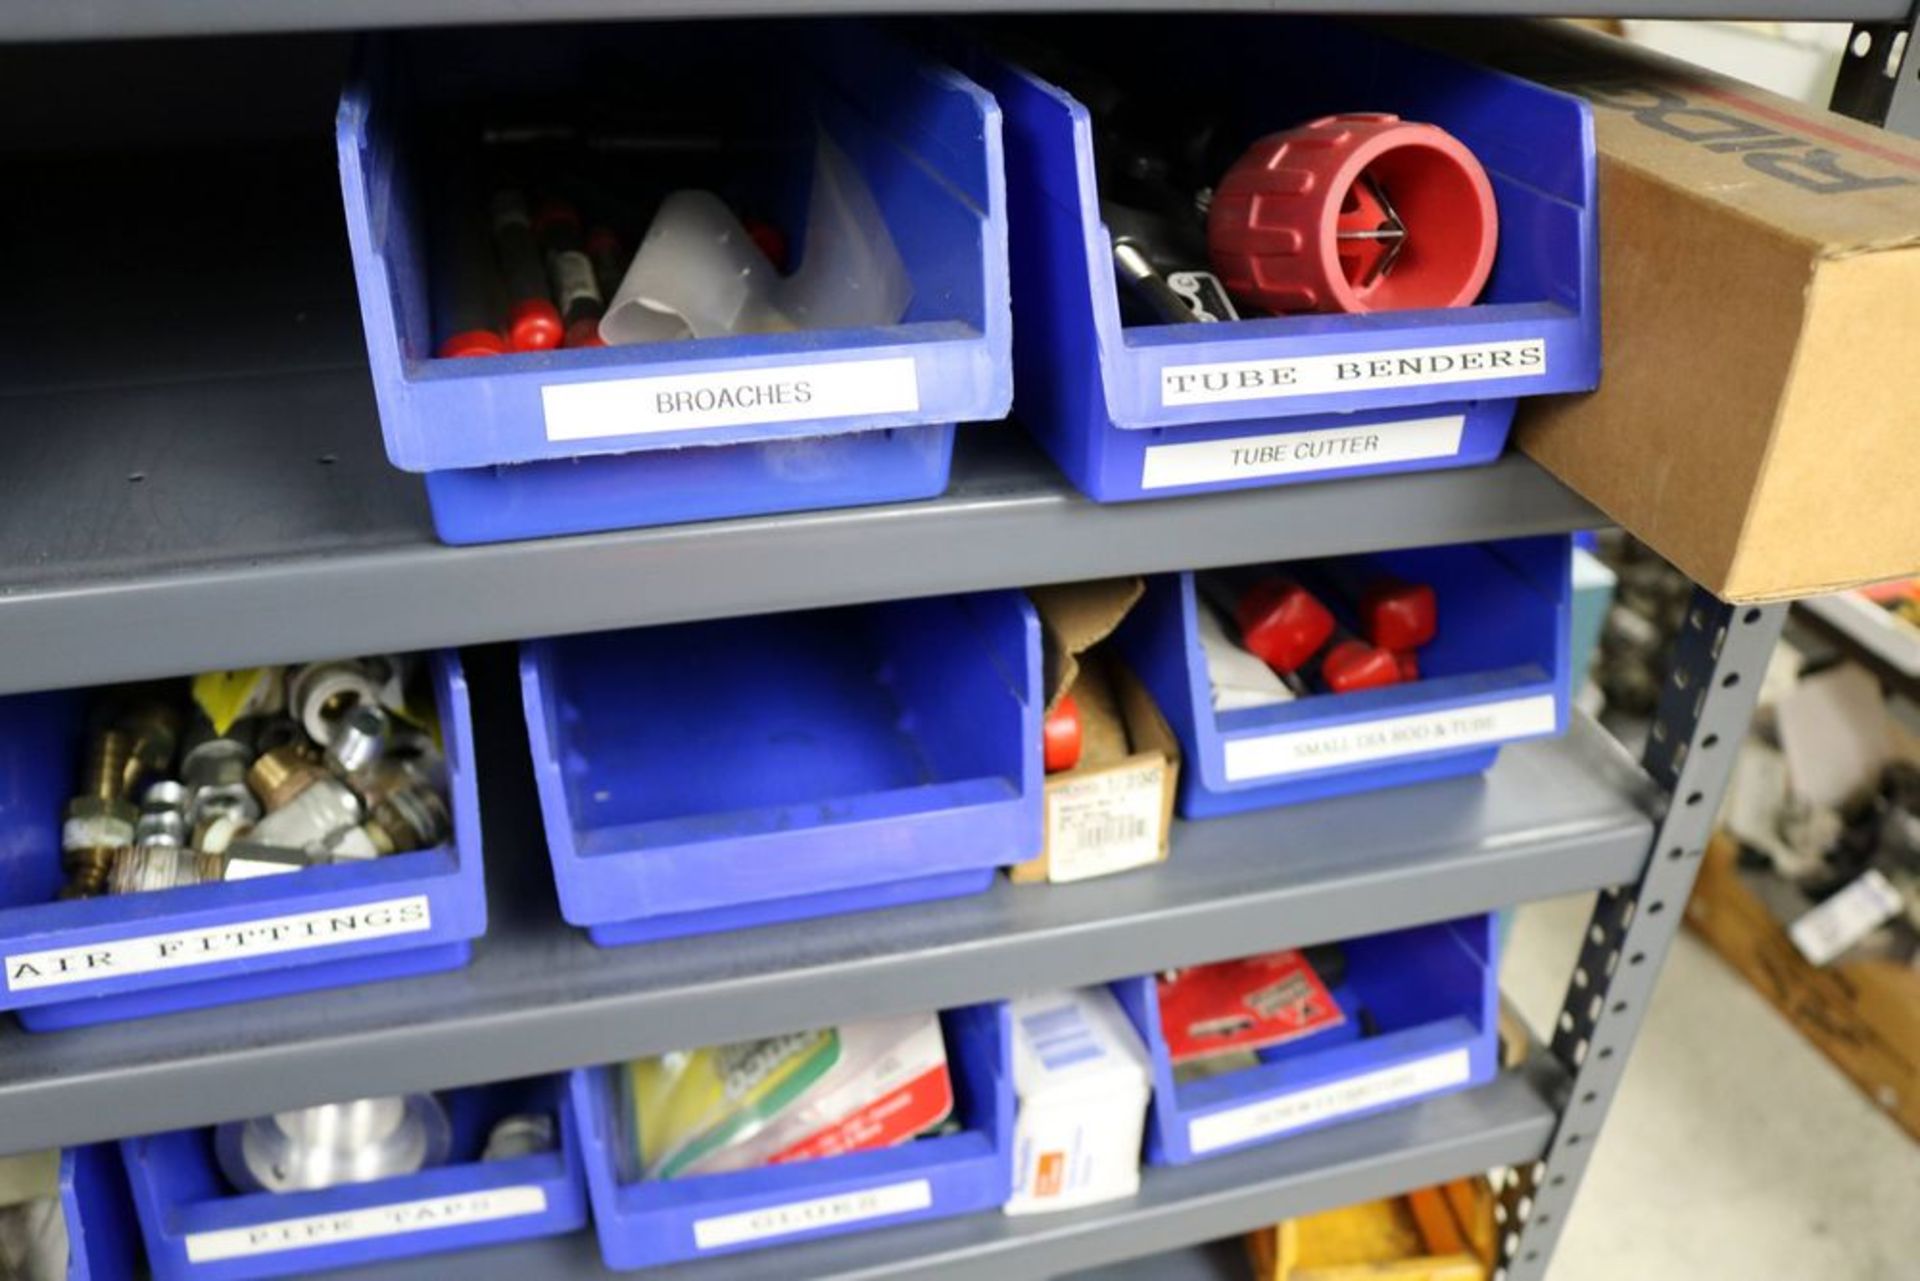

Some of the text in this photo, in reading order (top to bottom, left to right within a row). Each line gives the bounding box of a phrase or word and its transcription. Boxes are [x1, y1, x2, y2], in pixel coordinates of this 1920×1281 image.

[1166, 346, 1542, 394] TUBE BENDERS
[655, 380, 813, 415] BROACHES
[1231, 434, 1380, 467] TUBE CUTTER
[13, 902, 425, 979] AIR FITTINGS
[249, 1217, 352, 1244] PIPE
